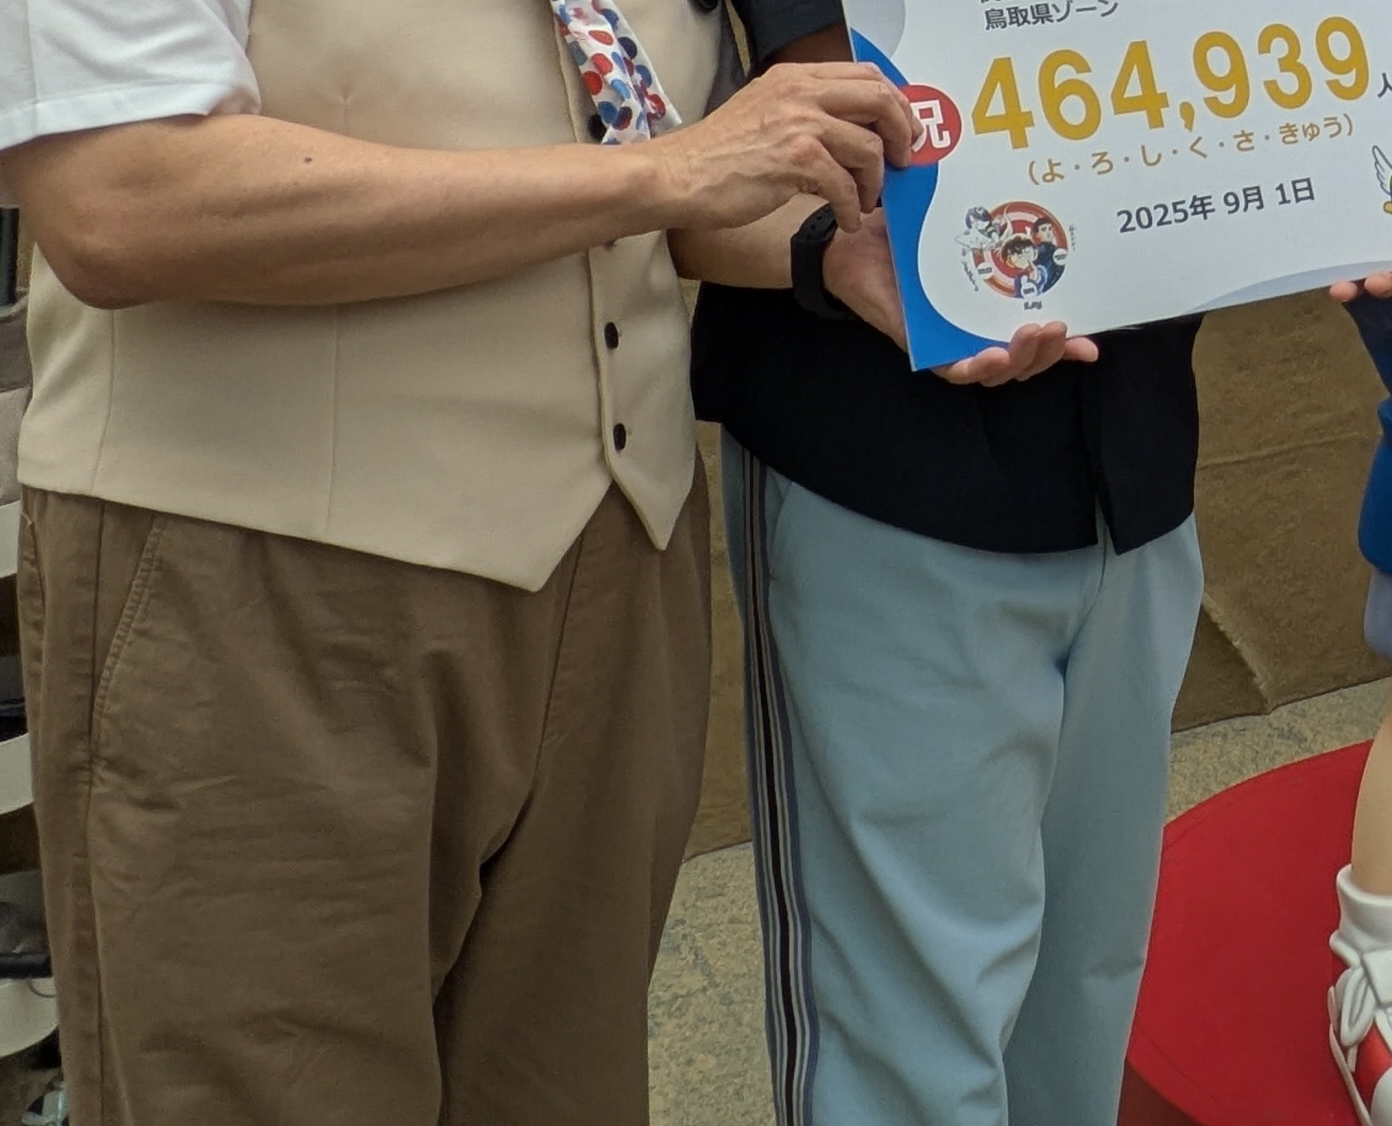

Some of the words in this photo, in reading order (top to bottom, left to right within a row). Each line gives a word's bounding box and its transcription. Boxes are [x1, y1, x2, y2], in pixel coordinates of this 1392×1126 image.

[971, 15, 1371, 150] 464,939
[1028, 114, 1355, 186] (よ・ろ・し・く・さ・きゅう)
[1117, 194, 1215, 234] 2025年
[1223, 185, 1266, 216] 9月
[1274, 177, 1316, 206] 1日
